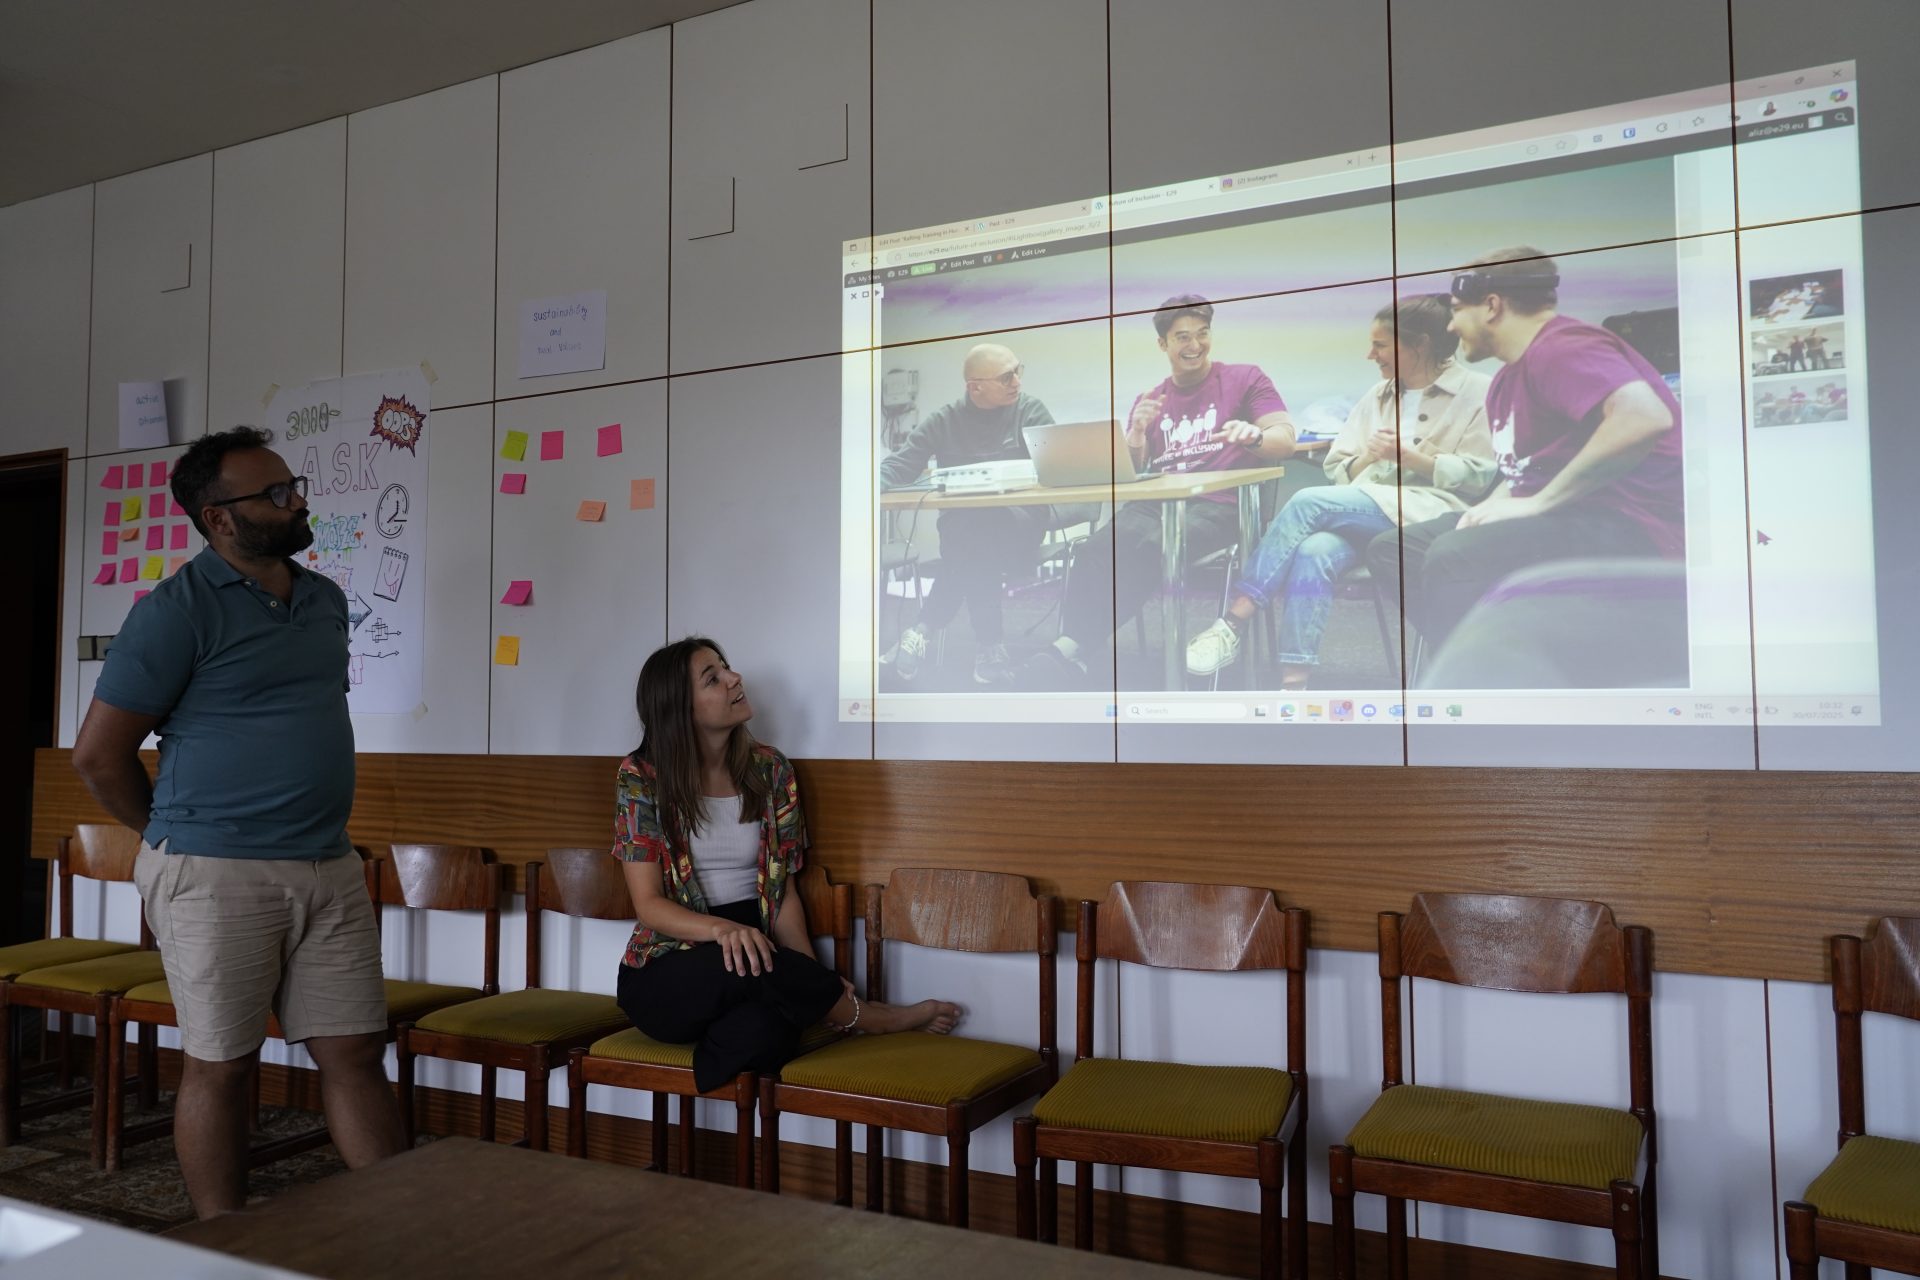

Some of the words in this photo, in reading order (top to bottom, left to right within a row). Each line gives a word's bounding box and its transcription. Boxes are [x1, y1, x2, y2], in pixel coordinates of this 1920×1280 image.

[1247, 172, 1279, 184] Instagram
[1021, 250, 1033, 258] Edit
[950, 259, 961, 268] Edit
[962, 257, 975, 266] Post
[1182, 442, 1224, 457] INCLUSION
[1694, 703, 1713, 711] ENG
[1694, 712, 1715, 720] INTL
